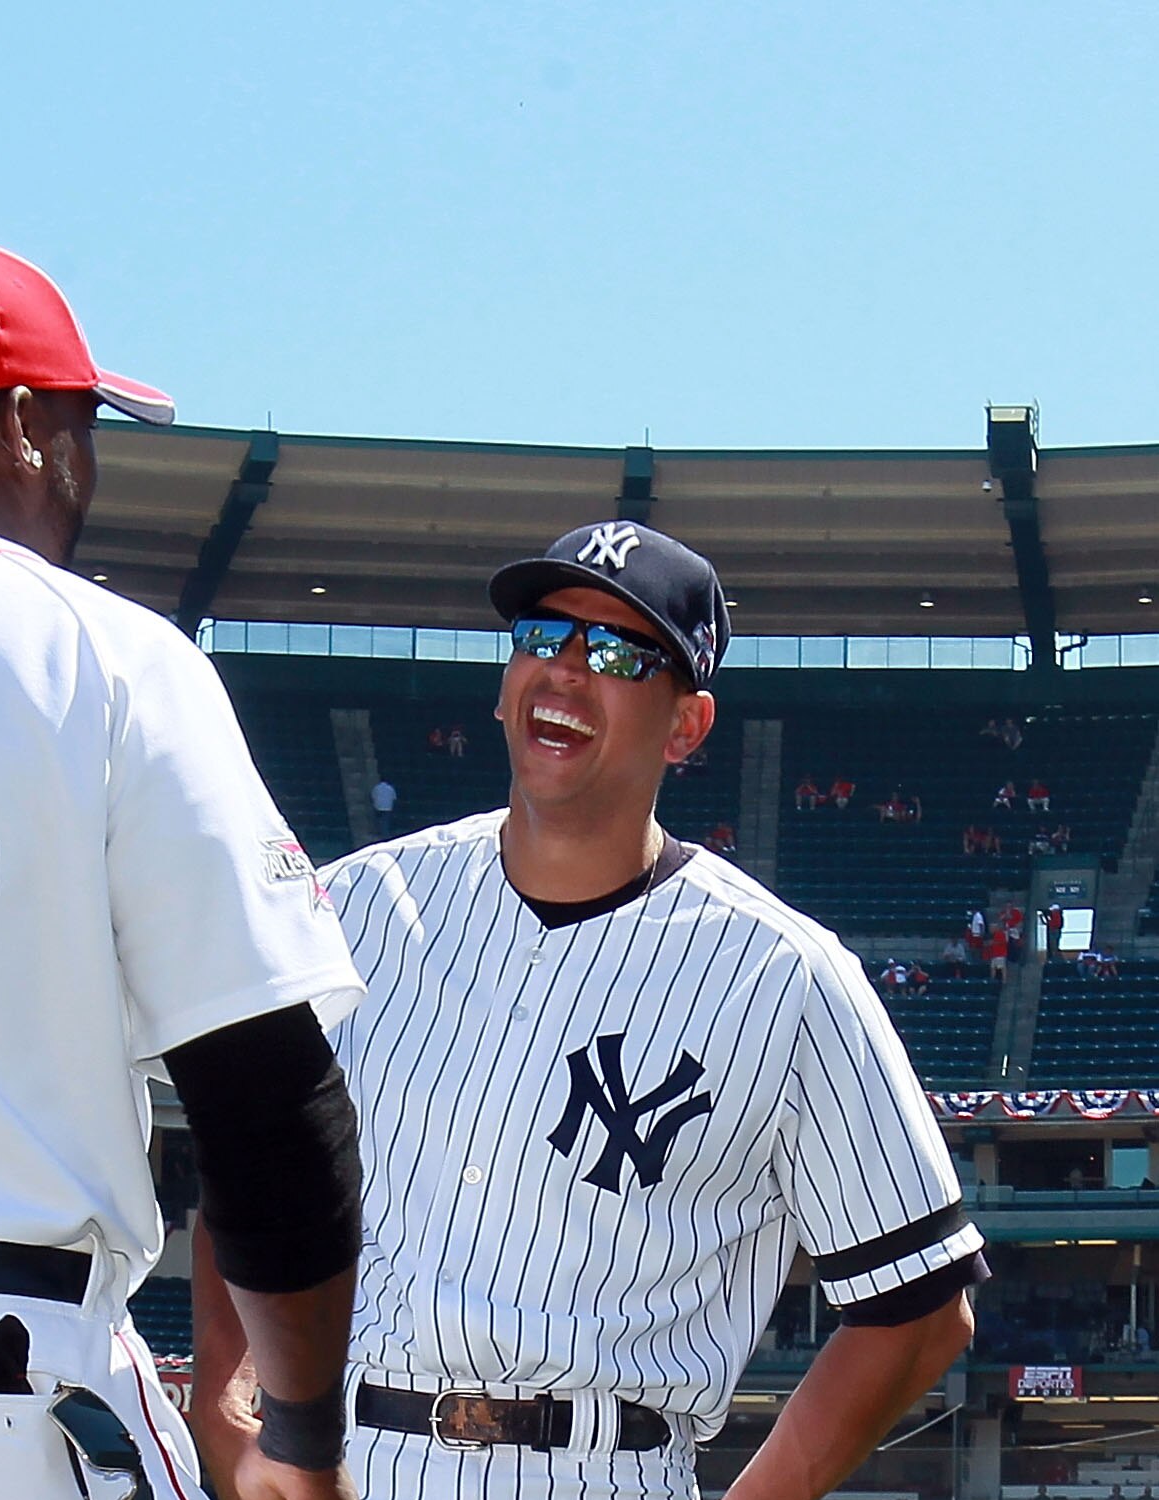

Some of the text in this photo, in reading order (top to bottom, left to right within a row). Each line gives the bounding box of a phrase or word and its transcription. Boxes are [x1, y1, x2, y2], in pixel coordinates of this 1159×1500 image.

[577, 522, 641, 570] NY
[546, 1032, 713, 1195] NY
[1018, 1379, 1074, 1389] DEPORTES
[1024, 1366, 1072, 1379] ESPN
